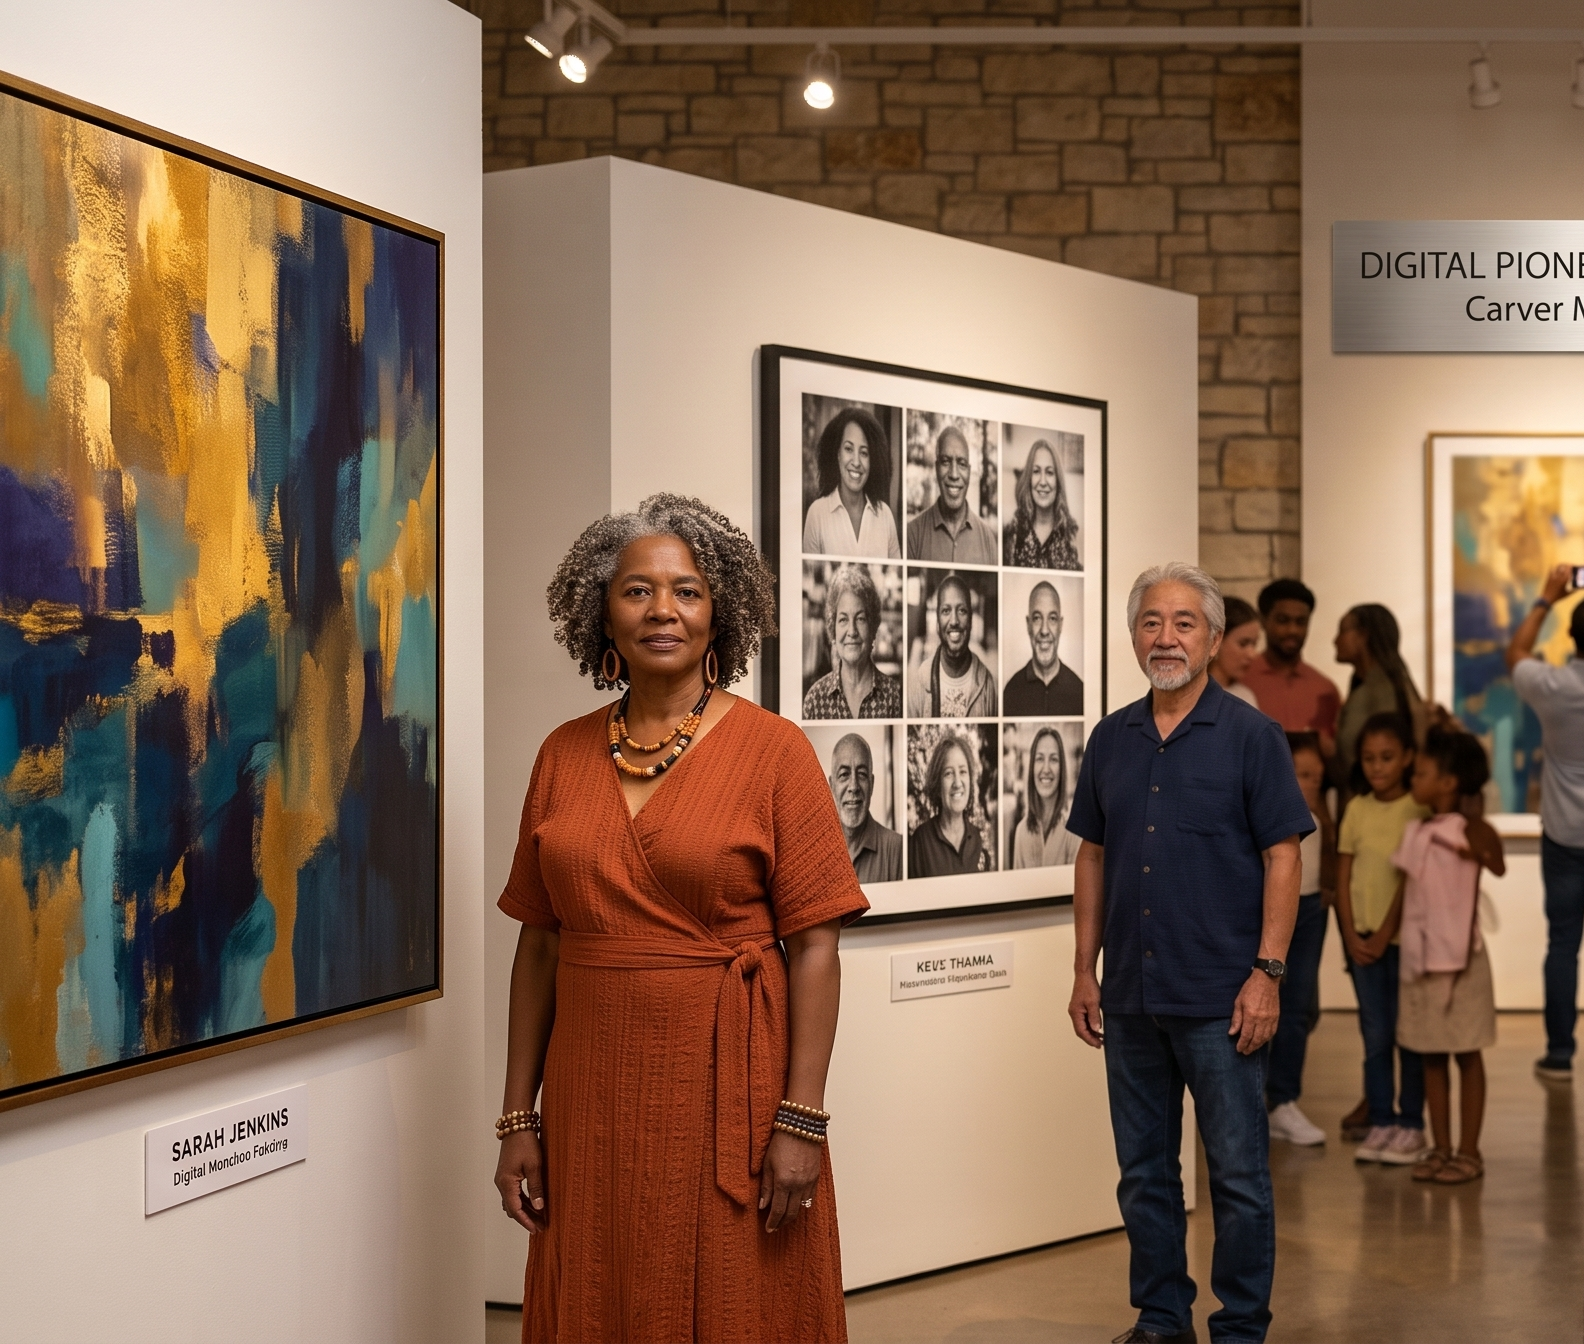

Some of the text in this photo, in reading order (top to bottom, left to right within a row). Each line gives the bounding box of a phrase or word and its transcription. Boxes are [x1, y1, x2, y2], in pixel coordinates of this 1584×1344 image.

[1361, 251, 1486, 279] DIGITAL
[1465, 295, 1563, 322] Carver
[172, 1107, 289, 1162] SARAH JENKINS
[173, 1162, 206, 1187] Digital
